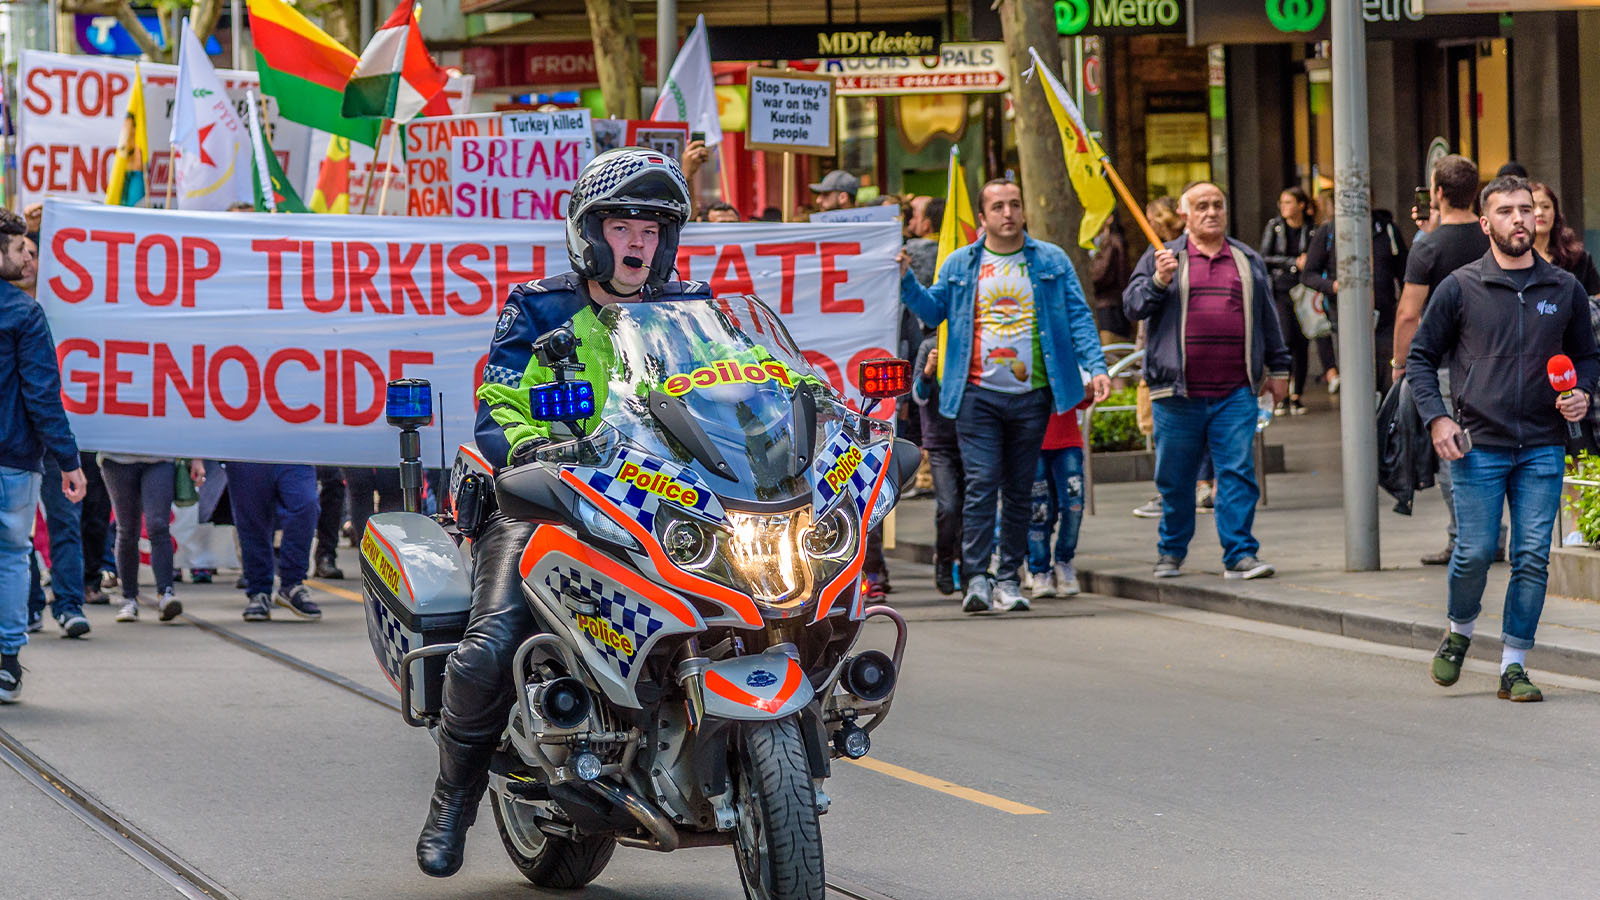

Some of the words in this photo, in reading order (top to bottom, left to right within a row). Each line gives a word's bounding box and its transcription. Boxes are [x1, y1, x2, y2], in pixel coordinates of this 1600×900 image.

[1094, 0, 1179, 26] Metro
[24, 67, 129, 117] STOP
[755, 80, 779, 96] Stop
[783, 82, 827, 99] Turkey's
[763, 98, 783, 108] war
[786, 100, 799, 109] on
[803, 99, 819, 110] the
[770, 111, 812, 125] Kurdish
[510, 117, 549, 135] Turkey
[552, 113, 583, 130] killed
[773, 128, 808, 141] people
[407, 157, 449, 185] FOR
[49, 228, 221, 308] STOP
[252, 237, 546, 317] TURKISH
[676, 242, 864, 314] TATE
[618, 461, 699, 505] Police
[826, 447, 861, 492] Police
[379, 555, 400, 593] PATROL
[578, 614, 633, 655] Police
